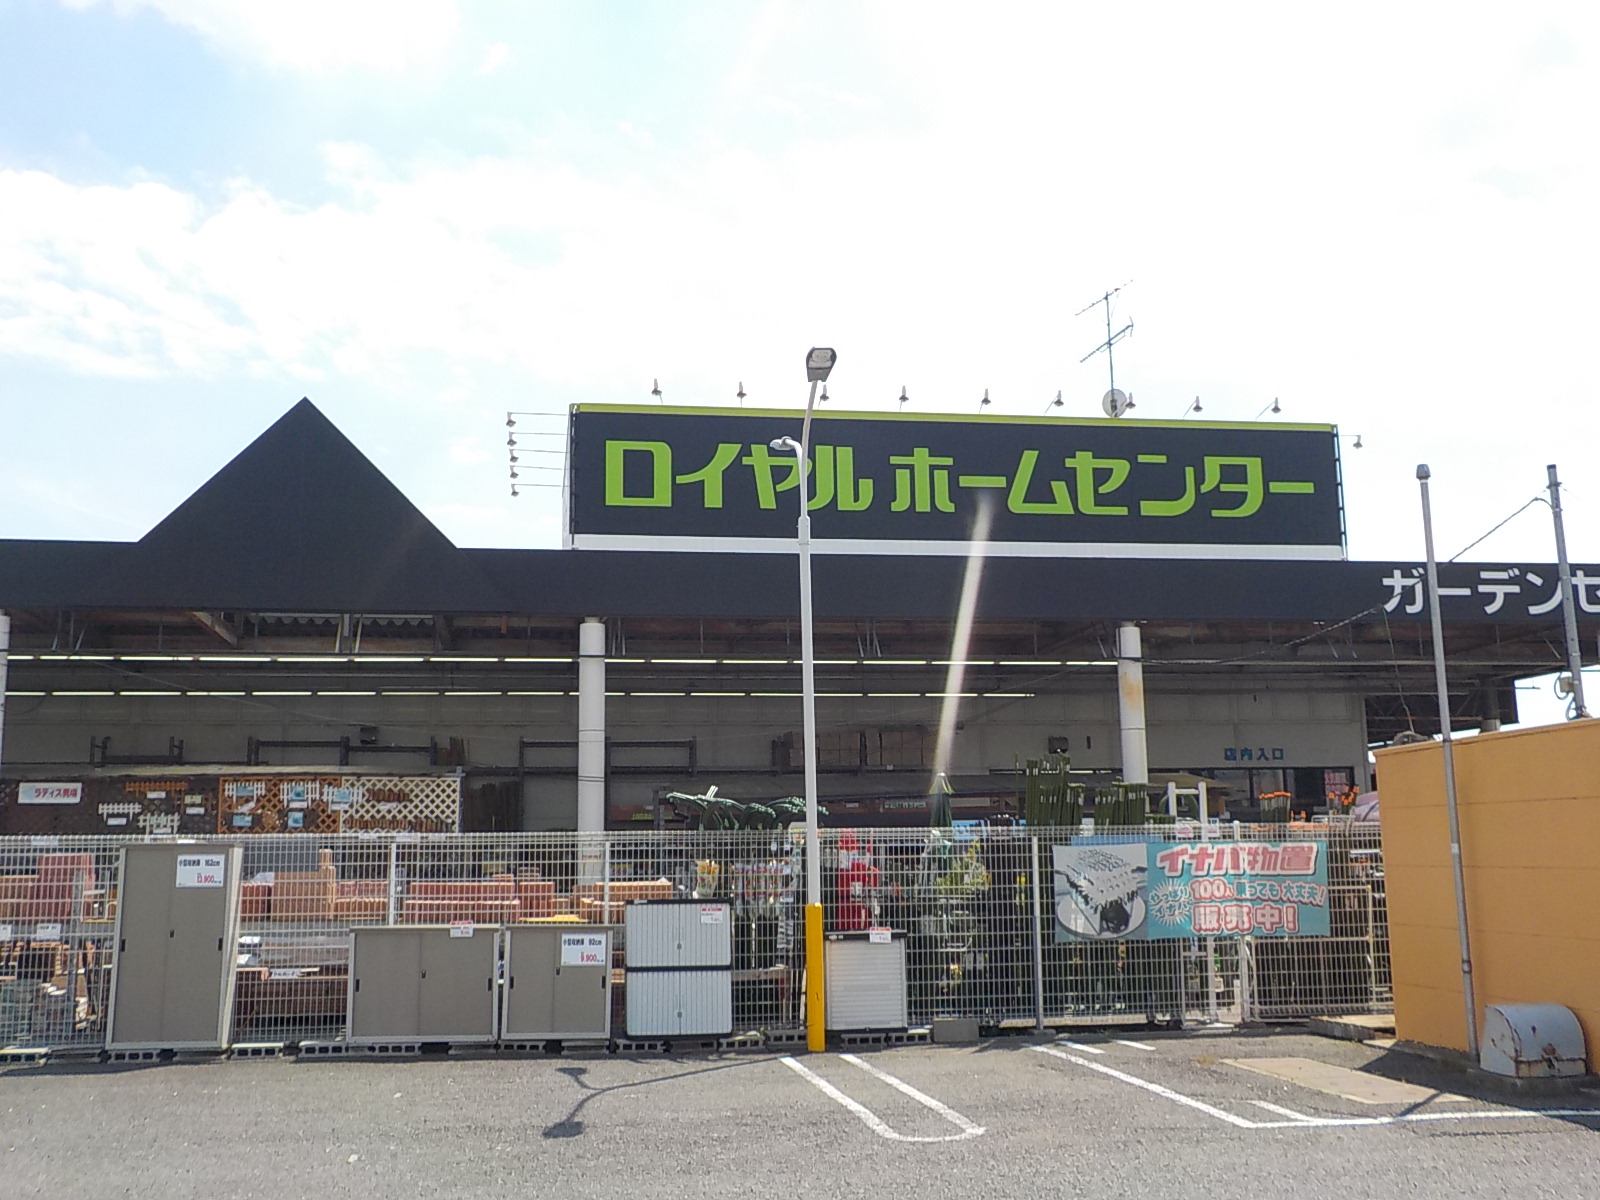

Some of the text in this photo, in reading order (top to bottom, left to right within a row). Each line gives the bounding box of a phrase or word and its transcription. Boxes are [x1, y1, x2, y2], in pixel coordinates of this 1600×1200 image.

[1224, 747, 1284, 761] 店内入口
[1158, 844, 1316, 876] イナバ物置
[1193, 904, 1298, 934] 販売中!
